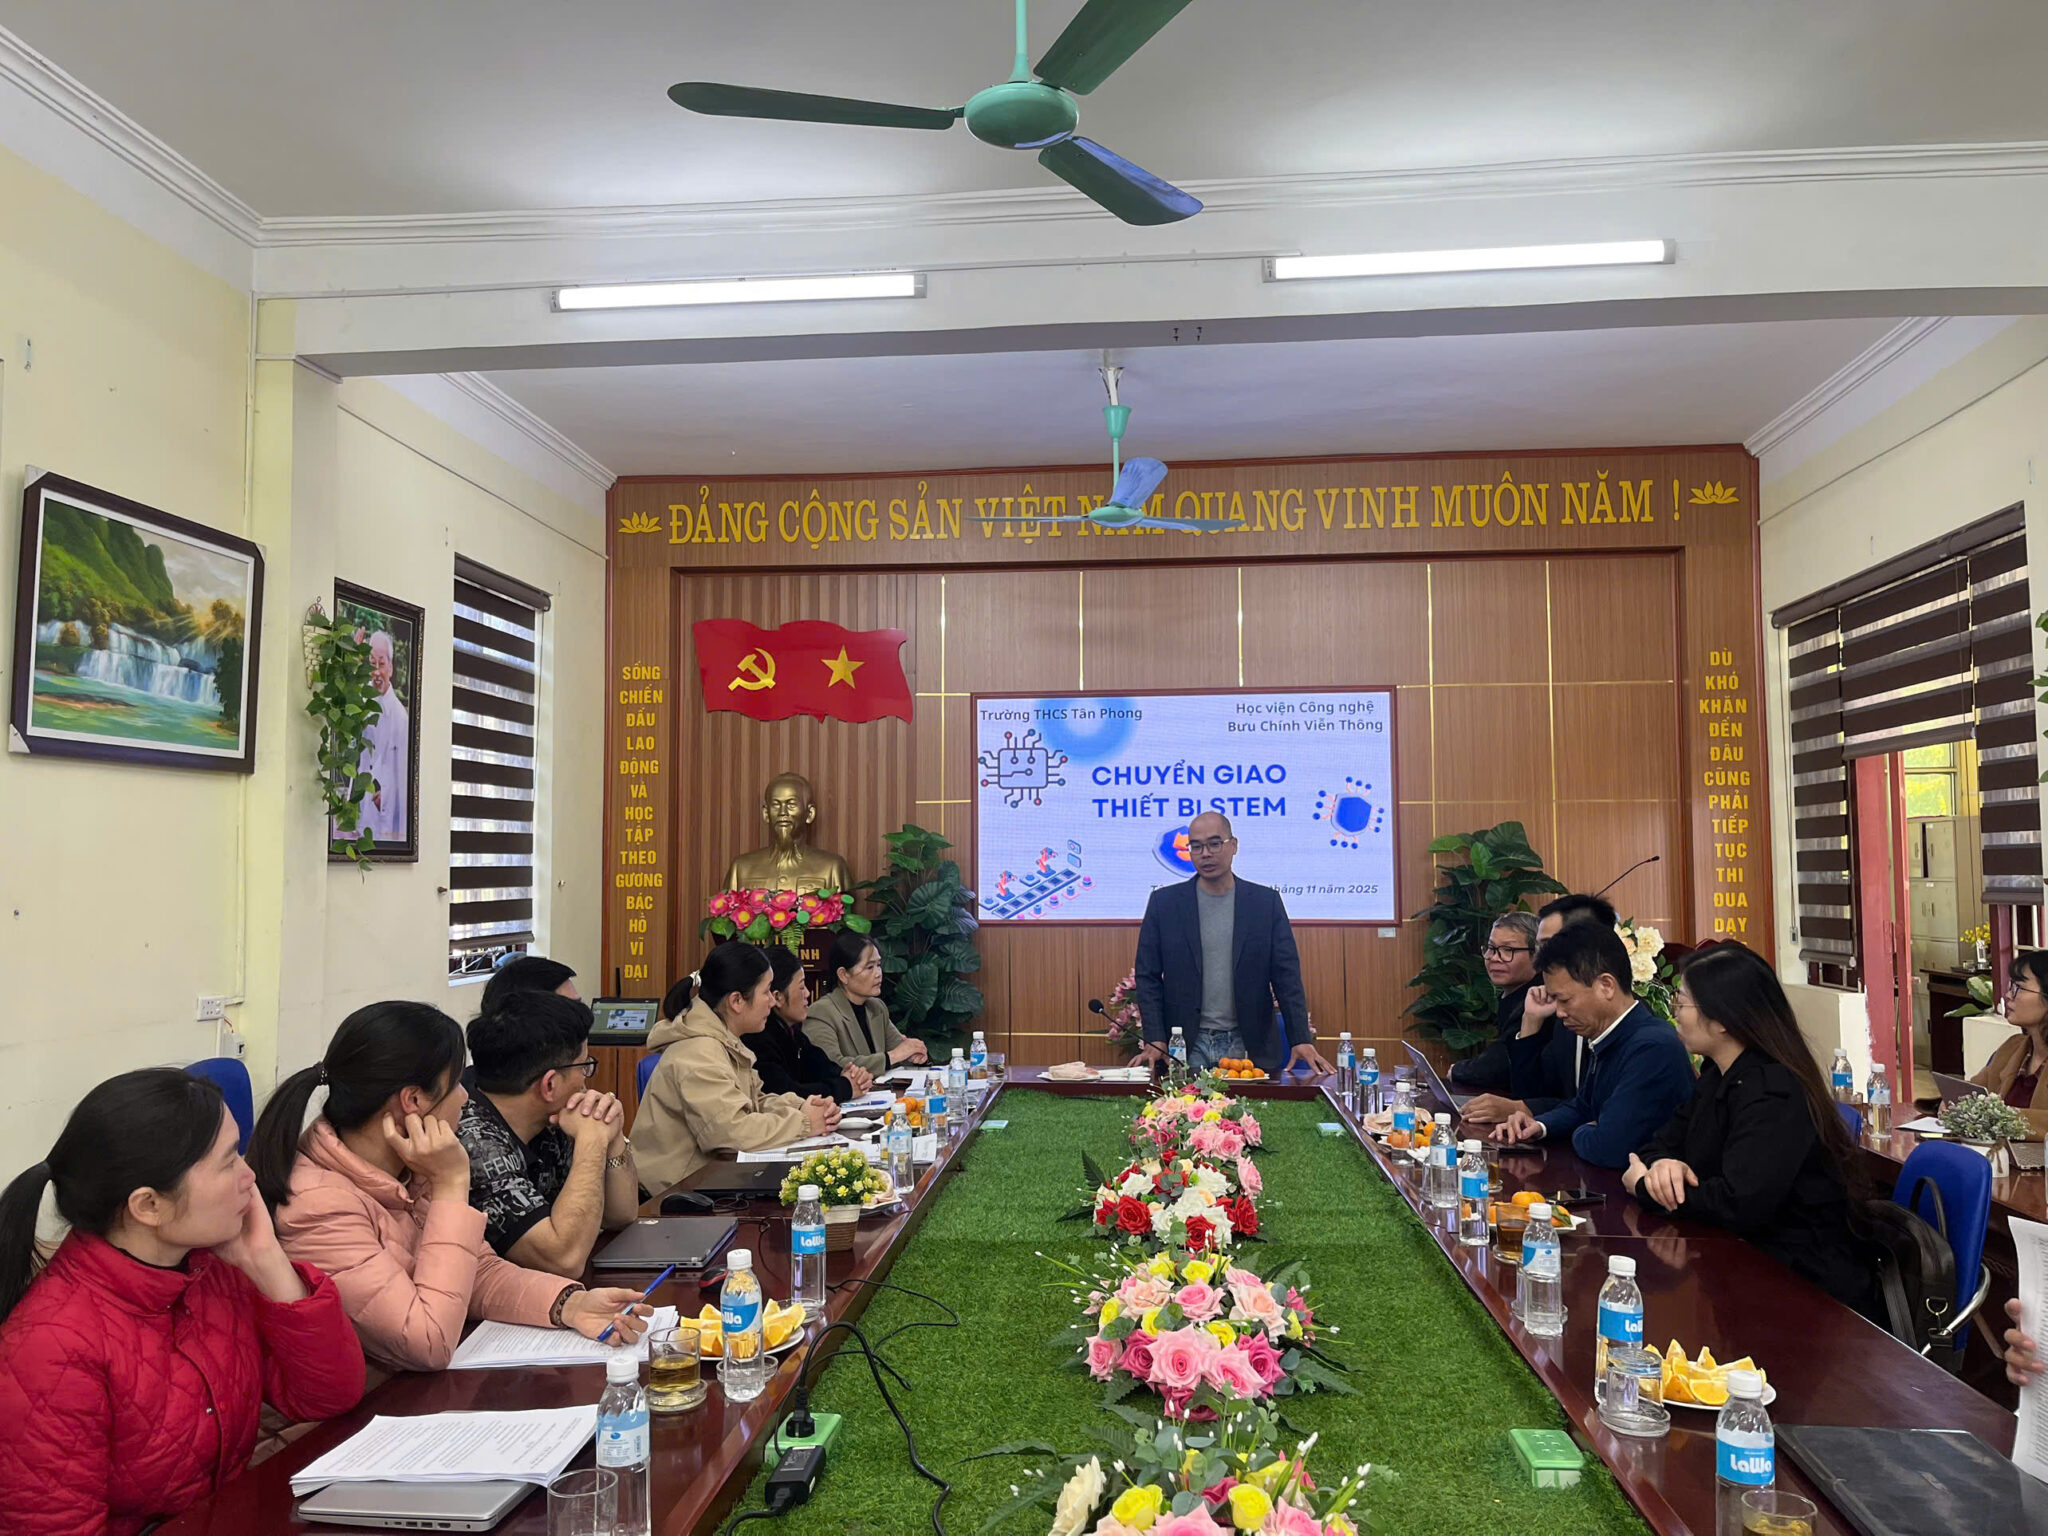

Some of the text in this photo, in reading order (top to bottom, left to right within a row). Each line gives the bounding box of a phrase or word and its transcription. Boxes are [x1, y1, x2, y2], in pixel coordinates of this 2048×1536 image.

[668, 485, 769, 544] ĐẢNG
[778, 488, 879, 549] CỘNG
[888, 480, 963, 540] SẢN
[974, 483, 1066, 545] VIỆT
[1077, 493, 1165, 537] NM
[1174, 488, 1307, 537] QUANG
[1313, 486, 1420, 530] VINH
[1431, 471, 1550, 528] MUÔN
[1561, 469, 1655, 525] NĂM
[1709, 647, 1732, 666] DÙ
[622, 661, 661, 680] SỐNG
[1705, 671, 1739, 690] KHÓ
[619, 684, 663, 704] CHIẾN
[1236, 700, 1374, 717] Học viện Công nghệ
[1699, 695, 1747, 714] KHĂN
[626, 707, 656, 727] ĐẤU
[980, 707, 1143, 723] Trường THCS Tân Phong
[1228, 717, 1383, 733] Bưu Chính Viễn Thông
[1709, 716, 1743, 737] ĐẾN
[626, 736, 655, 751] LAO
[1710, 743, 1744, 762] ĐÂU
[619, 757, 659, 778] ĐỘNG
[1091, 759, 1287, 786] CHUYỂN GIAO
[1703, 766, 1750, 786] CŨNG
[630, 781, 648, 799] VÀ
[1092, 793, 1169, 818] THIẾT
[1210, 797, 1286, 817] STEM
[1708, 790, 1749, 810] PHẢI
[625, 806, 653, 824] HỌC
[1711, 813, 1749, 834] TIẾP
[625, 825, 654, 845] TẬP
[620, 850, 657, 865] THEO
[1714, 843, 1747, 862] TỤC
[615, 872, 663, 888] GƯƠNG
[1716, 867, 1744, 883] THI
[1306, 885, 1316, 894] 11
[1319, 884, 1345, 894] năm
[1348, 884, 1379, 894] 2025
[625, 892, 653, 910] BÁC
[1713, 892, 1749, 908] ĐUA
[628, 912, 647, 933] HỒ
[1714, 917, 1747, 936] DẠY
[630, 937, 645, 956] VĨ
[624, 964, 648, 982] ĐẠI
